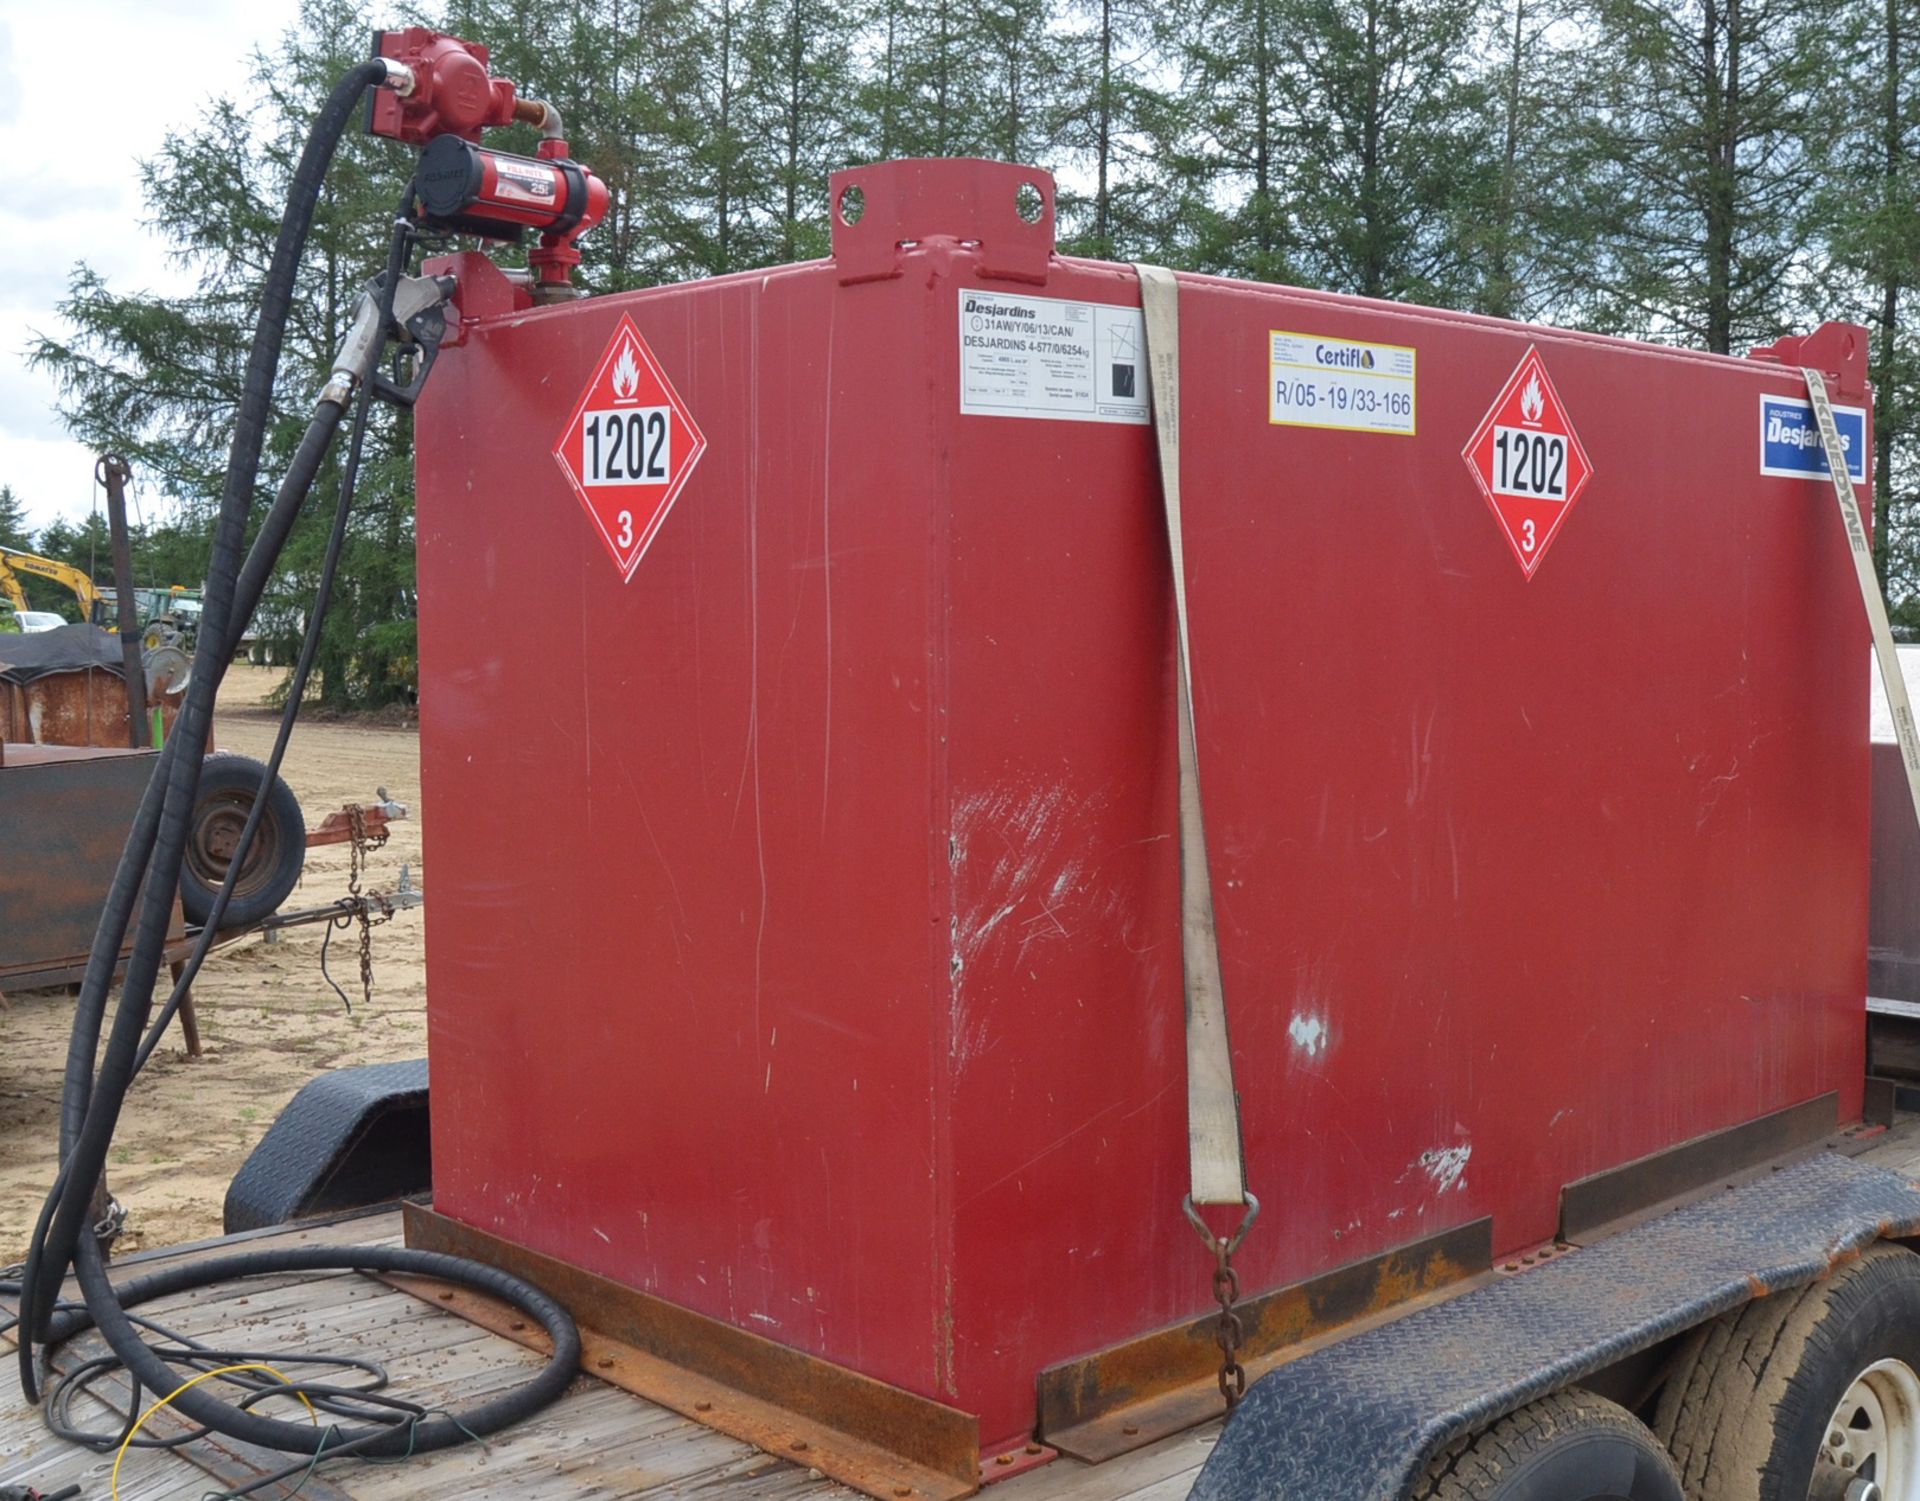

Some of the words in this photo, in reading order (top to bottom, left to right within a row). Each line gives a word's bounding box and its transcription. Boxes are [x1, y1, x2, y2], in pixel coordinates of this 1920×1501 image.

[965, 300, 1036, 319] Desjardins
[964, 336, 1026, 351] DESJARDINS
[1769, 409, 1803, 420] INDUSTRIES
[586, 411, 666, 480] 1202
[1766, 416, 1851, 451] Desjars
[1496, 430, 1564, 495] 1202
[1814, 395, 1866, 552] KINEDYNE
[617, 510, 633, 548] 3
[1522, 519, 1536, 552] 3
